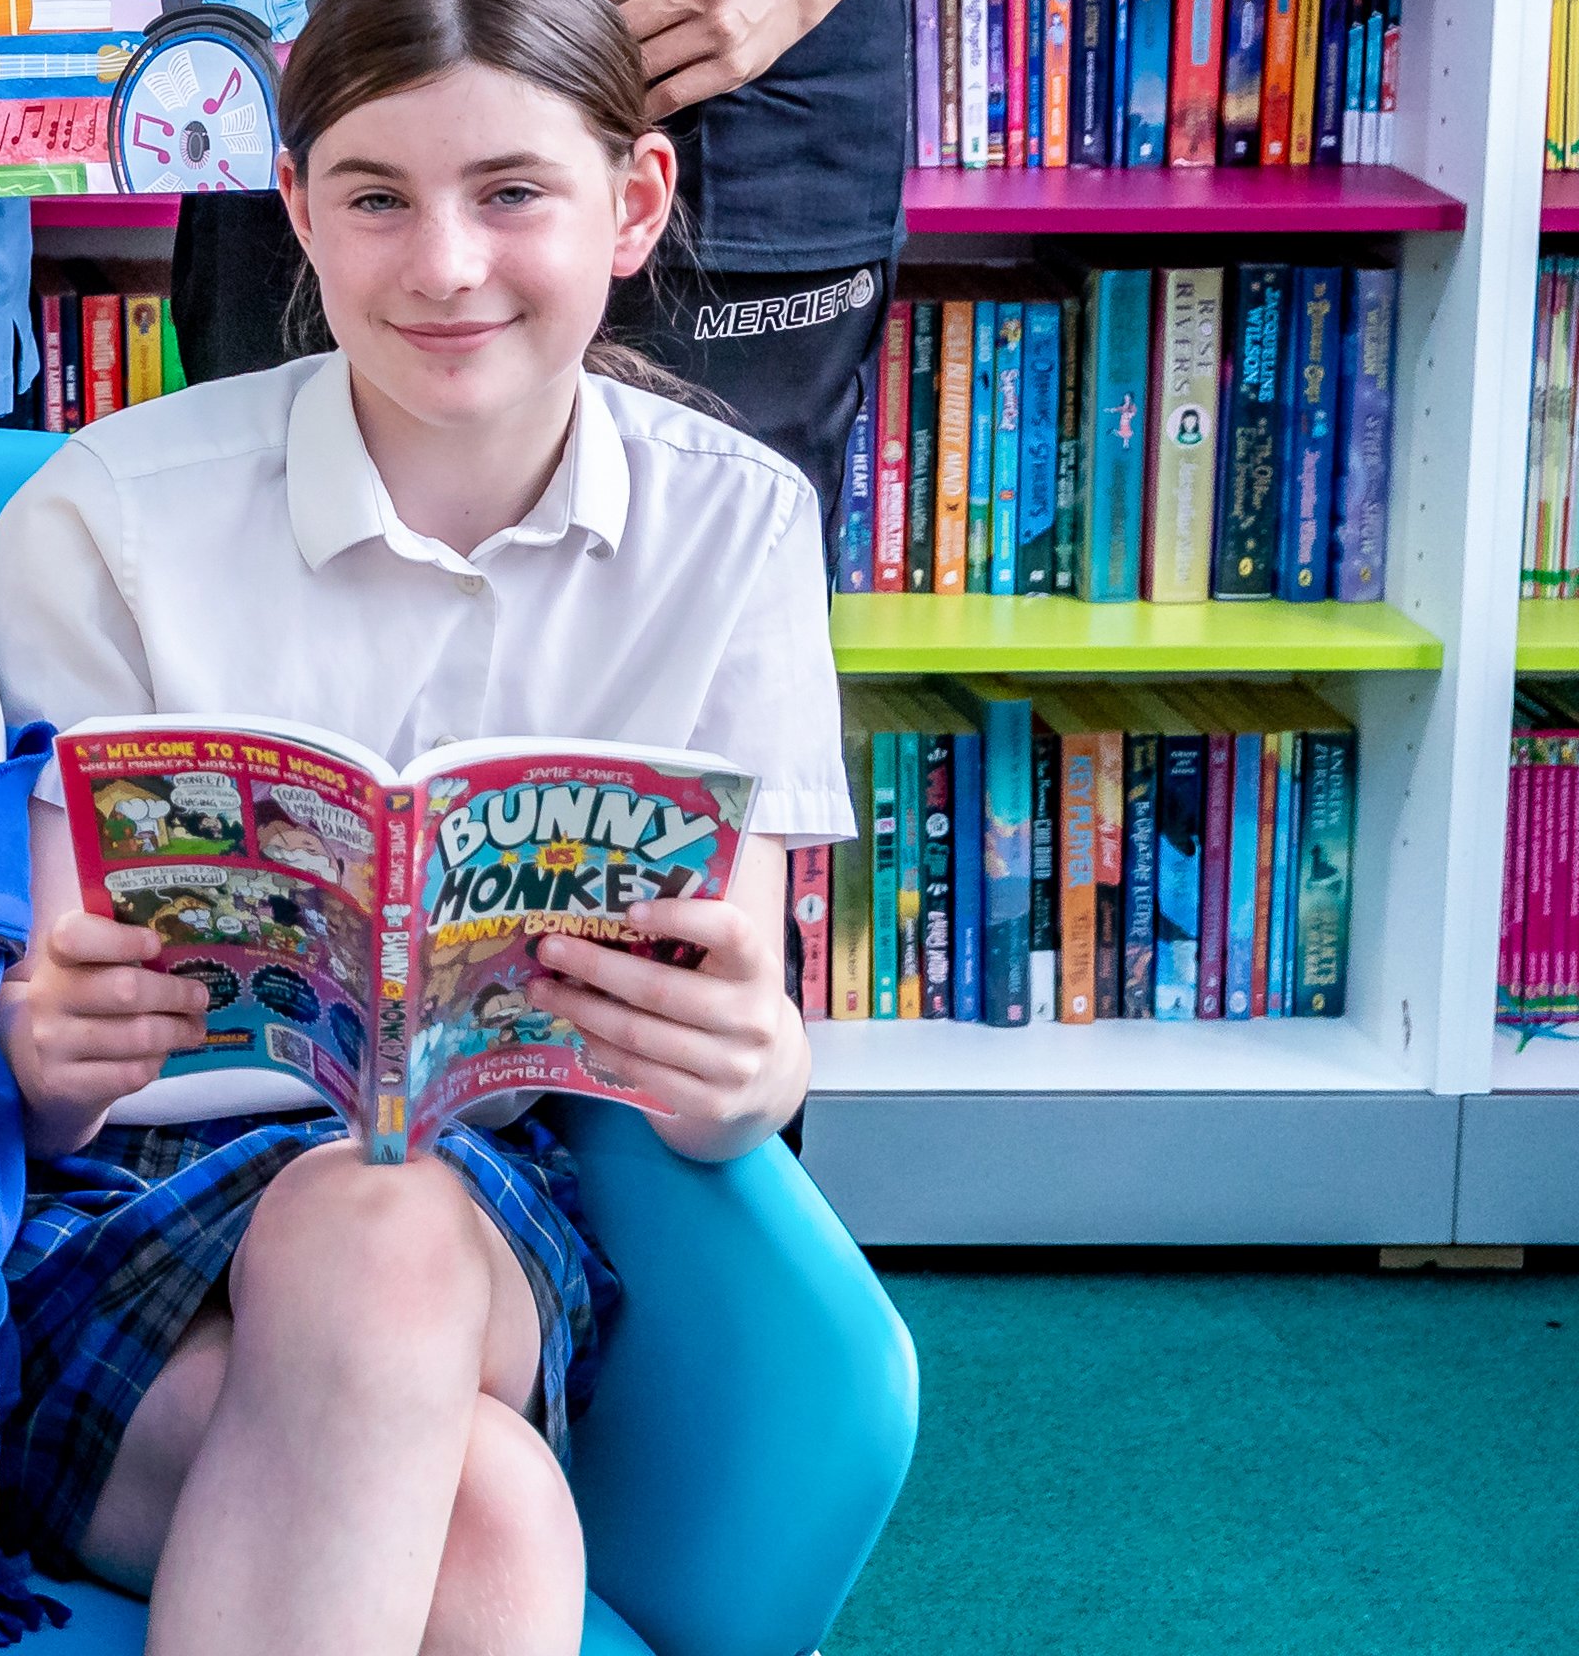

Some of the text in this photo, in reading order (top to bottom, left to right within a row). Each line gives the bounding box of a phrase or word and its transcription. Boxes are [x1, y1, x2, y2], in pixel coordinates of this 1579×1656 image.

[693, 278, 852, 341] MERCIER
[1173, 281, 1196, 395] RIVERS
[1196, 298, 1216, 376] ROSE
[1242, 306, 1263, 385] WILSON
[1258, 287, 1281, 403] JACQUELINE
[106, 742, 348, 790] WELCOME TO THE WOODS
[522, 766, 573, 781] JAMIE
[439, 786, 719, 872] BUNNY
[141, 875, 169, 886] JUST
[172, 873, 224, 886] ENOUGH!
[427, 863, 703, 932] MONKEY
[479, 1066, 569, 1086] RUMBLE!
